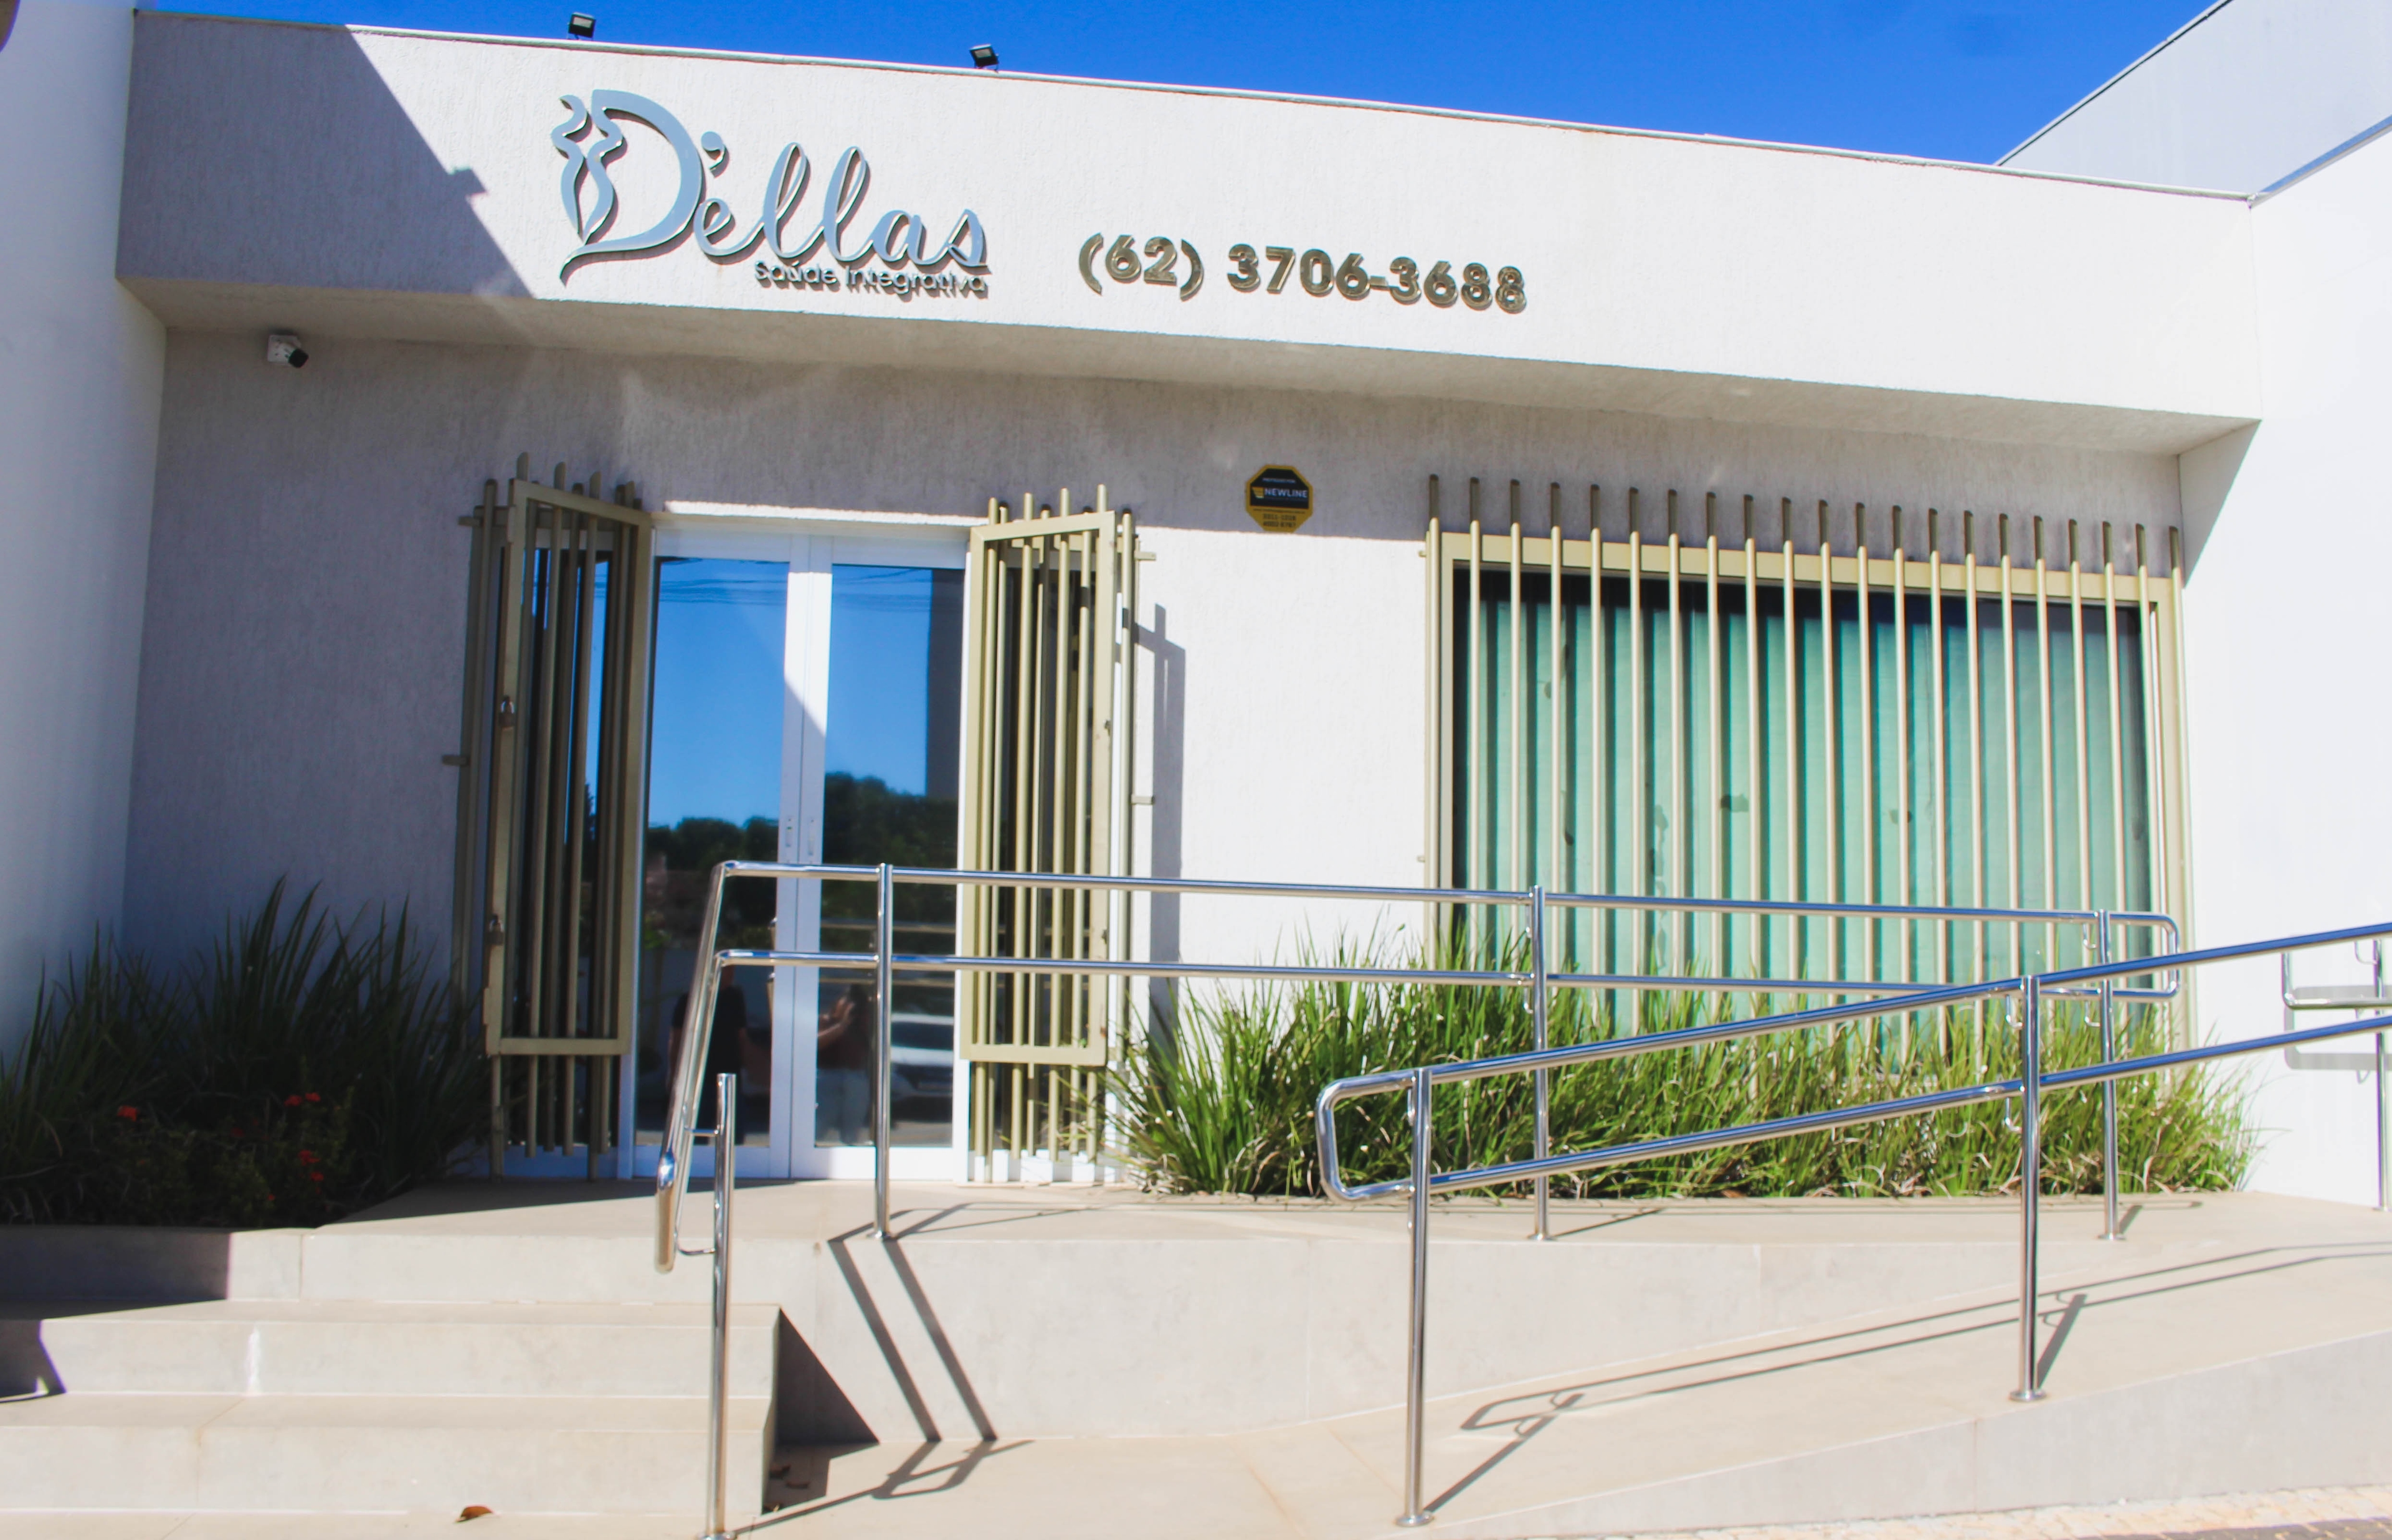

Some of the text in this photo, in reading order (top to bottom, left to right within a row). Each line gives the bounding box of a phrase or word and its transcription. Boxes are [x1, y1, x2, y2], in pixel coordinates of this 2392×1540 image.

[551, 89, 989, 286] D'ellas
[755, 260, 985, 295] Saúde Integrativa
[1079, 232, 1527, 314] (62) 3706-3688
[1264, 488, 1308, 498] NEWLINE
